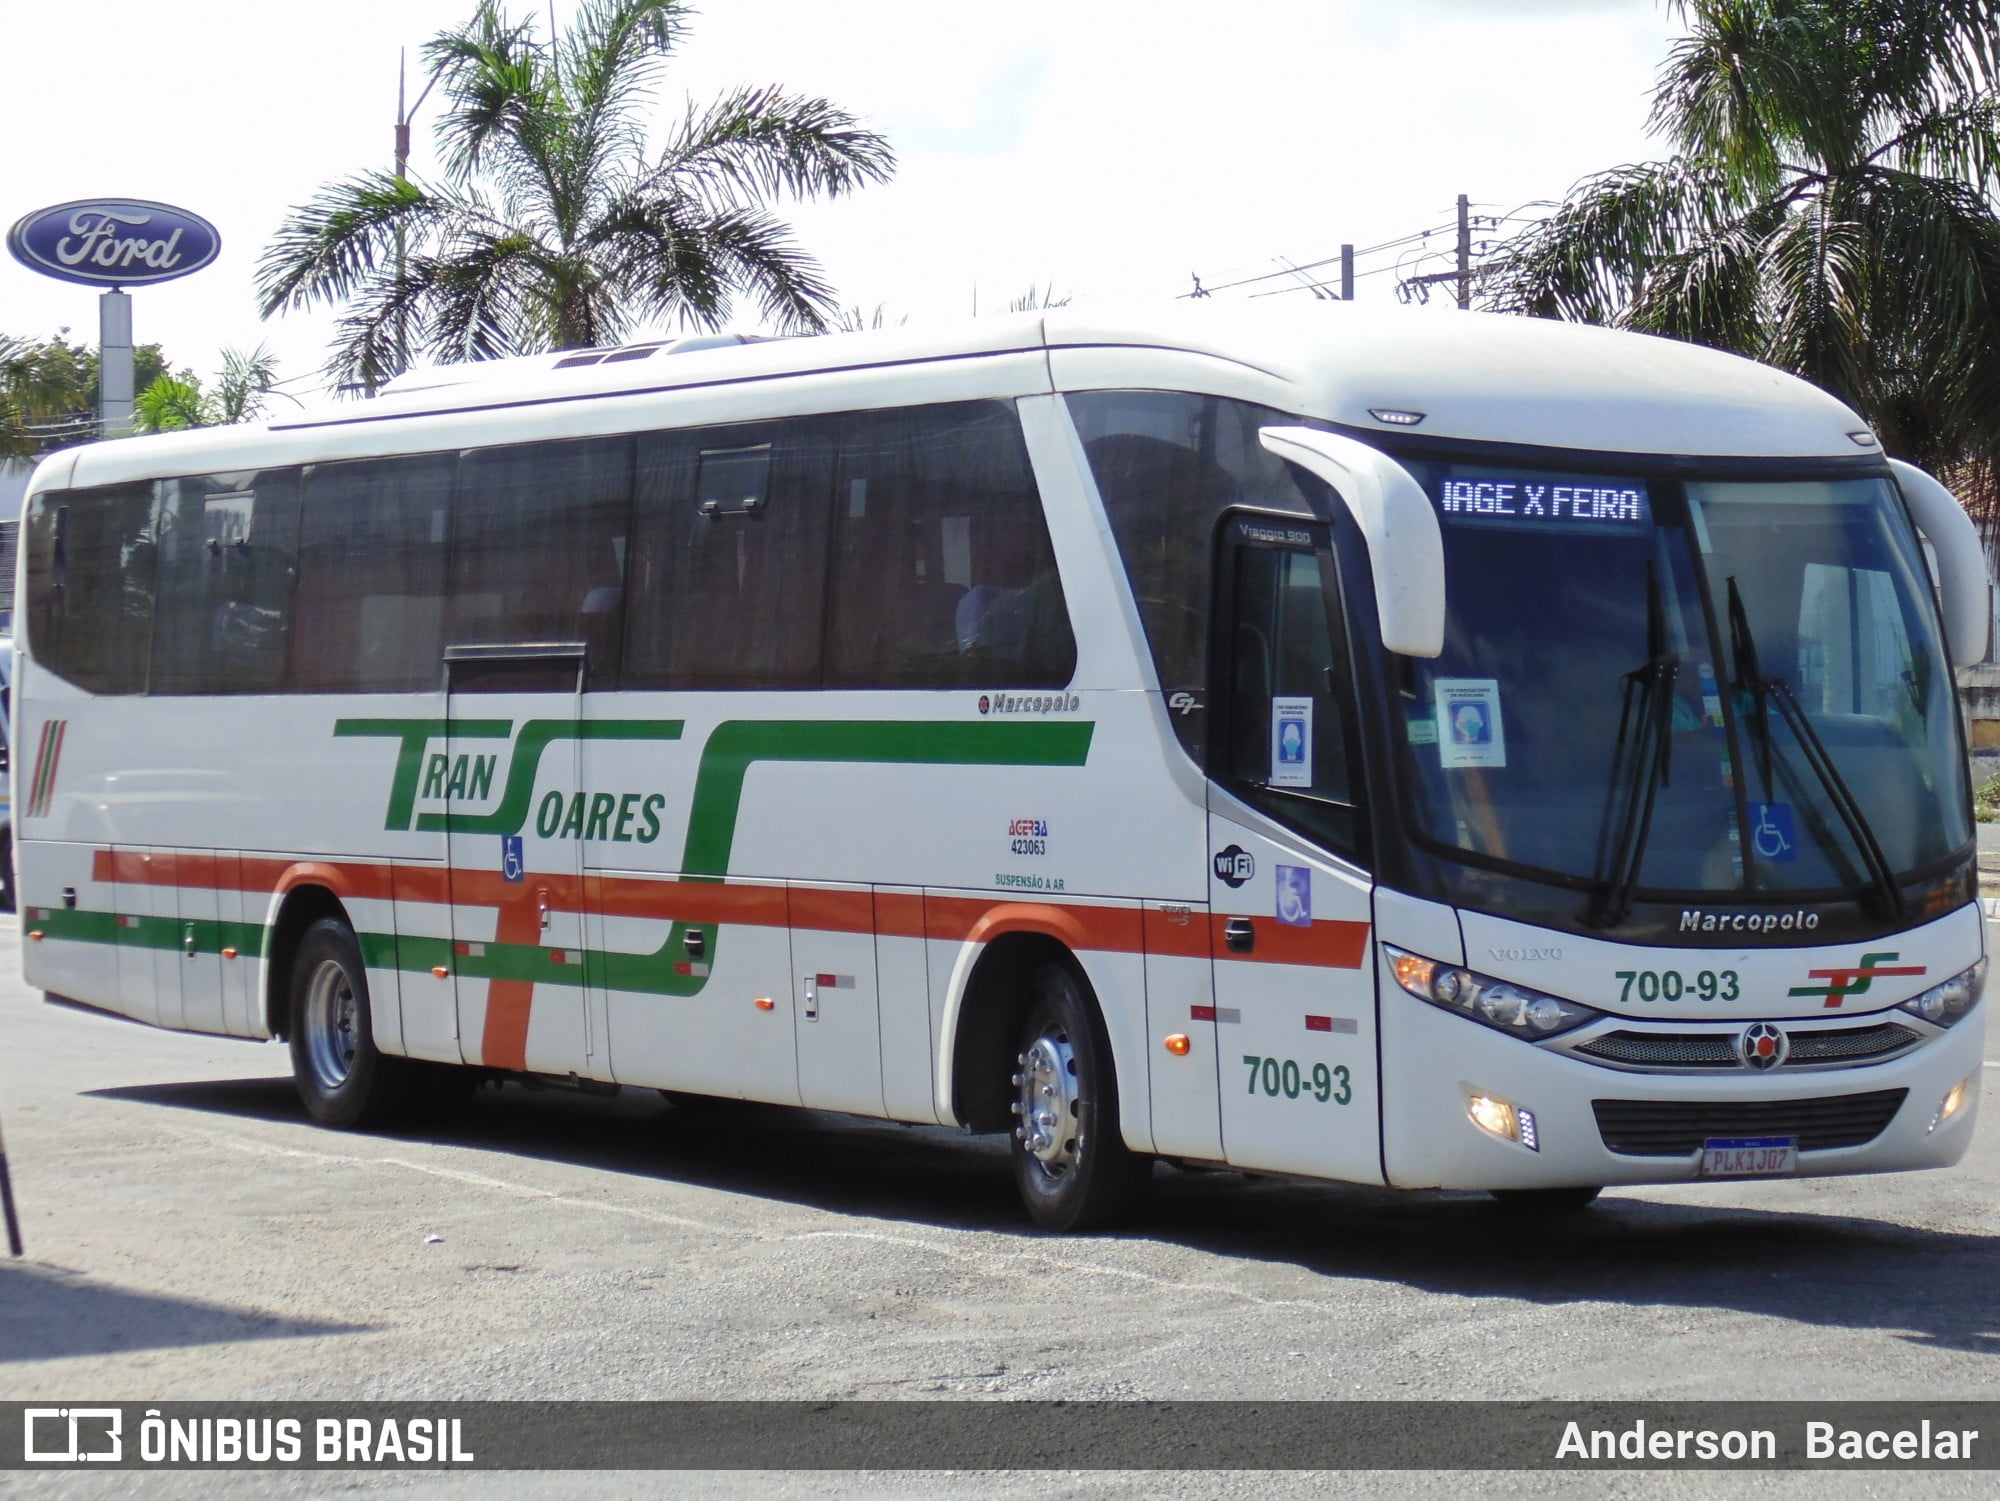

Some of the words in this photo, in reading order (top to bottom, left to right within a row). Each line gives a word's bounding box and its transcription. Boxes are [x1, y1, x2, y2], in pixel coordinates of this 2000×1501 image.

[56, 209, 183, 268] Ford
[1524, 486, 1544, 515] X
[1552, 487, 1640, 519] FEIRA
[1240, 523, 1285, 541] Viaggio
[1287, 530, 1311, 543] 900
[992, 693, 1080, 713] Marcopolo
[1011, 839, 1046, 855] 423063
[995, 873, 1043, 889] SUSPENSÃO
[1045, 878, 1051, 889] A
[1053, 879, 1065, 891] AR
[1679, 910, 1819, 932] Marcopolo
[1487, 948, 1563, 962] VOLVO
[1615, 970, 1740, 1002] 700-93
[1243, 1055, 1351, 1105] 700-93
